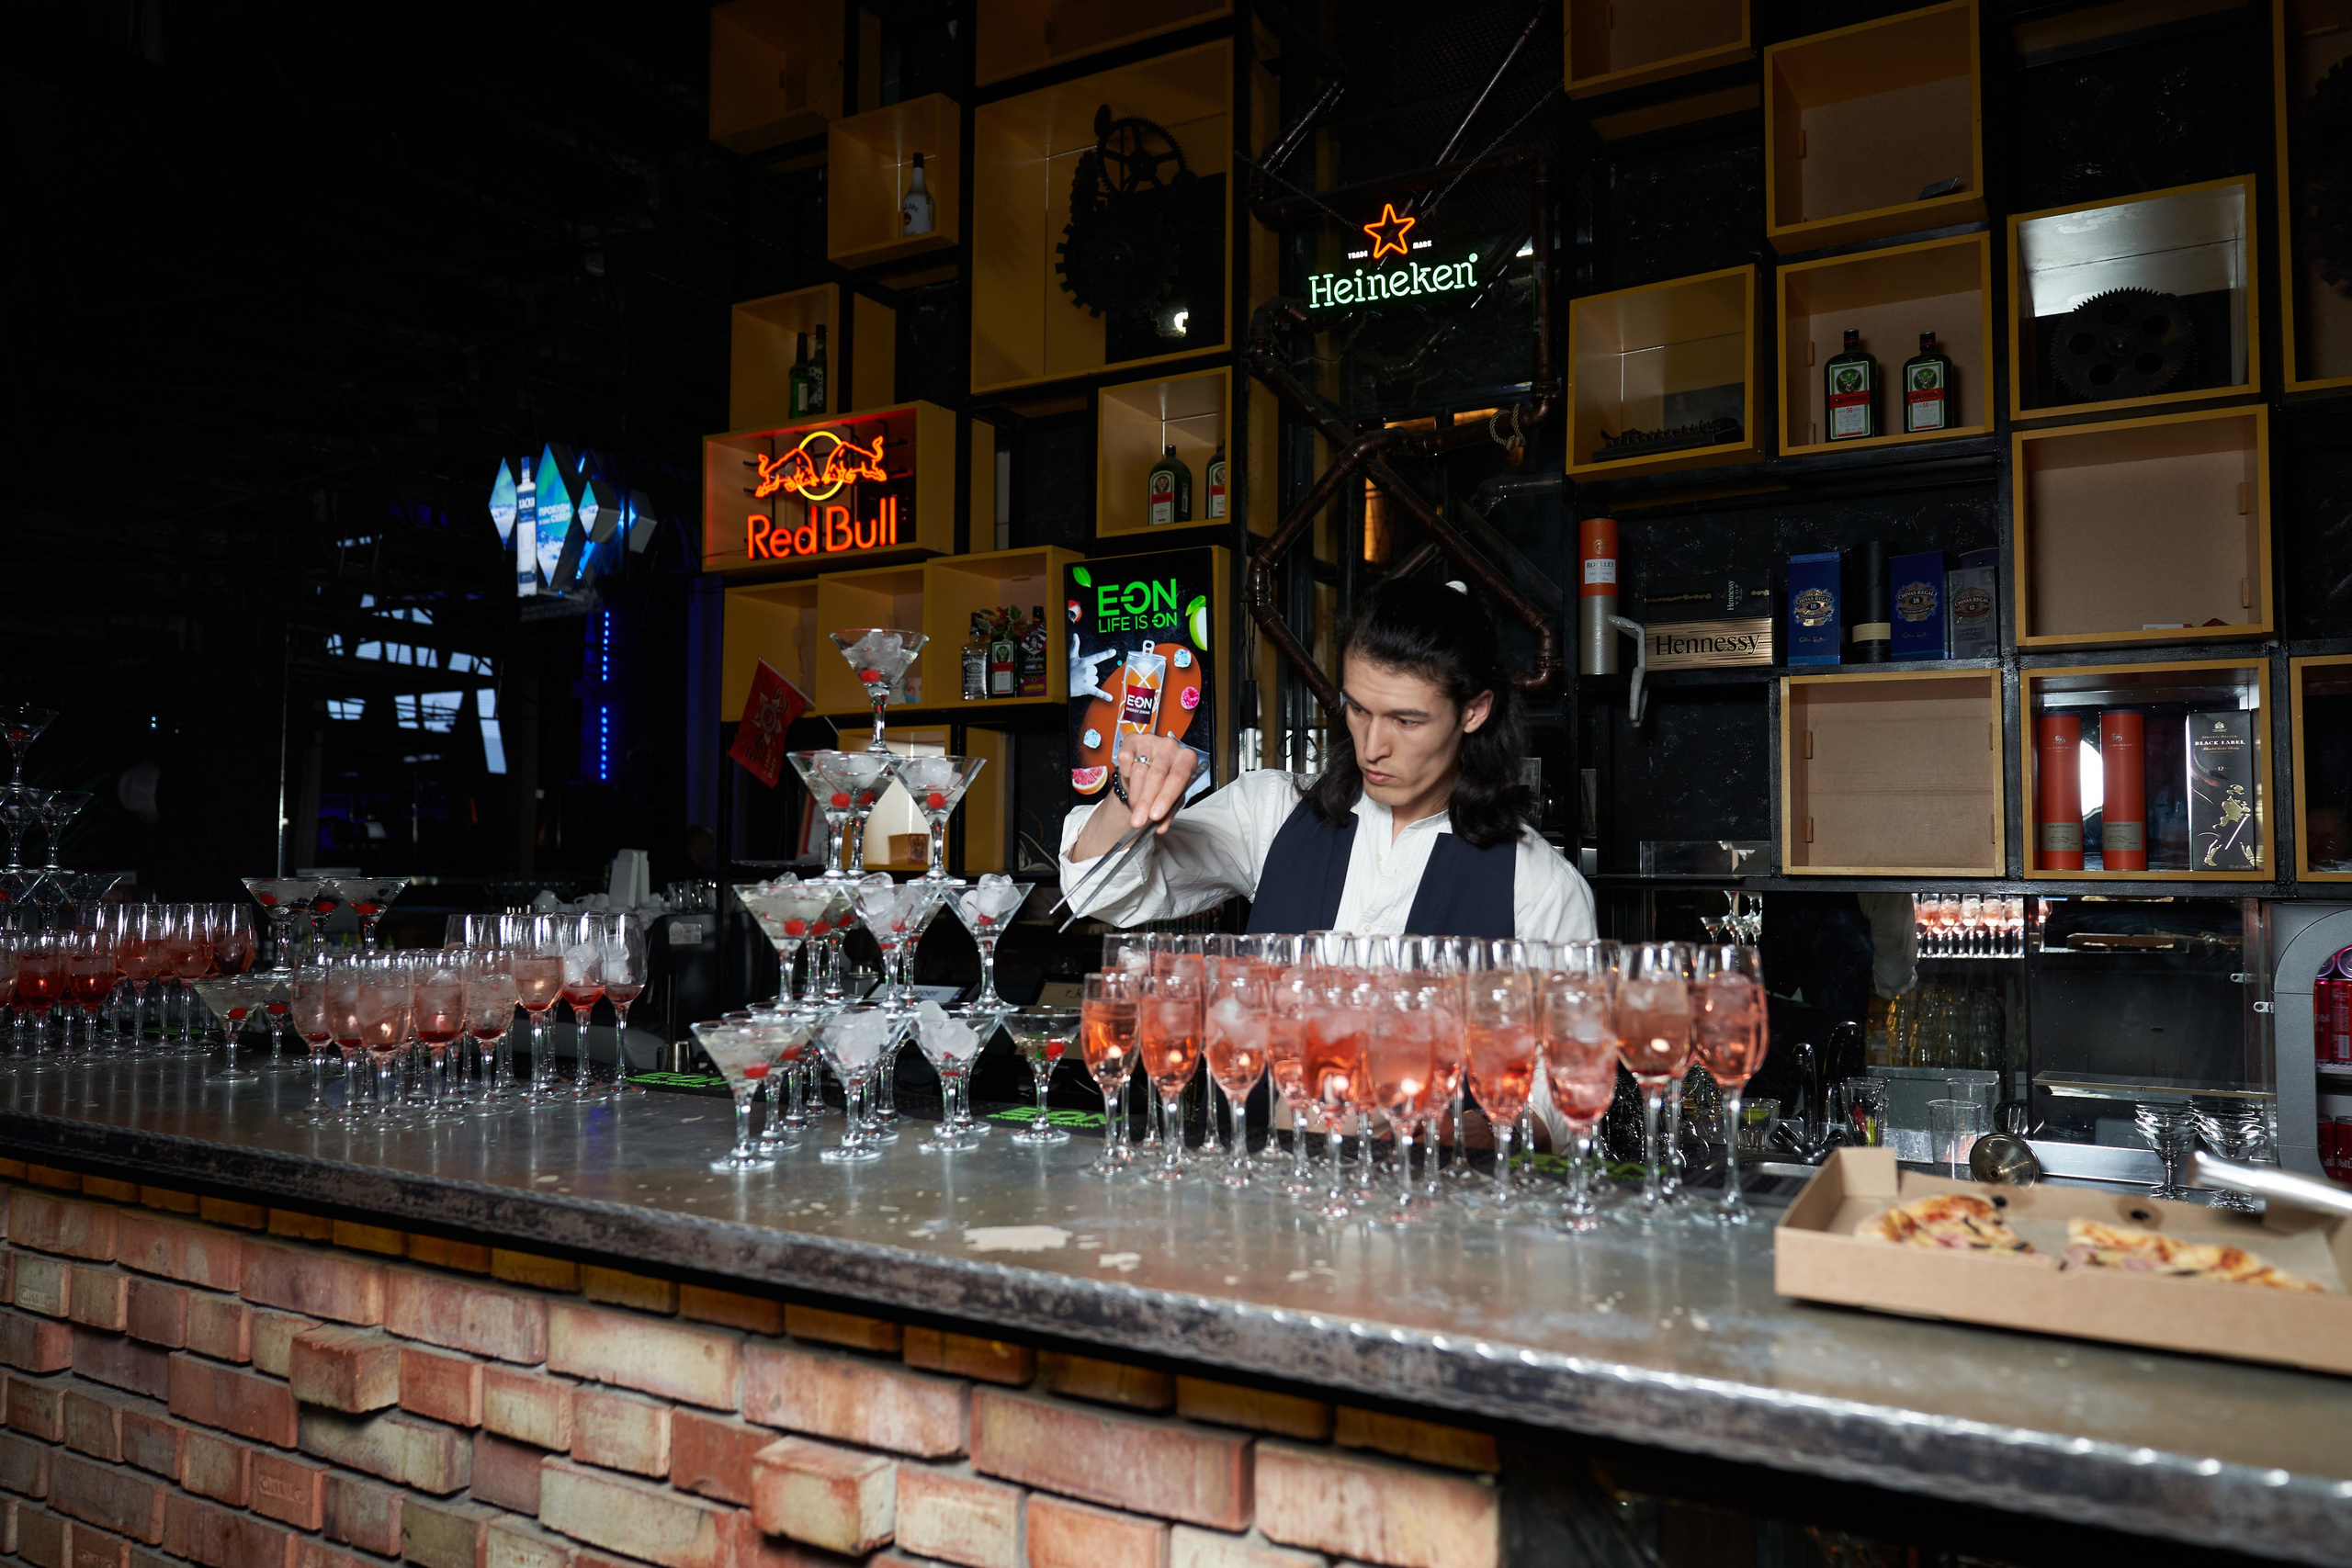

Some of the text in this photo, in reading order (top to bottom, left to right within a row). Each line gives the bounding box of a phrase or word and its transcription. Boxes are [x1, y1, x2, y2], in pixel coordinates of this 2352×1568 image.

[1348, 240, 1432, 260] TRADE MARK
[1308, 261, 1477, 309] Heineken
[747, 496, 897, 560] Red Bull
[1097, 578, 1178, 617] EON
[1726, 580, 1736, 611] Hennessy
[1897, 589, 1917, 600] CHIVAS
[1954, 597, 1973, 606] CHIVAS
[1098, 612, 1178, 633] LIFE IS ON
[1655, 634, 1761, 655] Hennessy
[1126, 694, 1153, 710] EON
